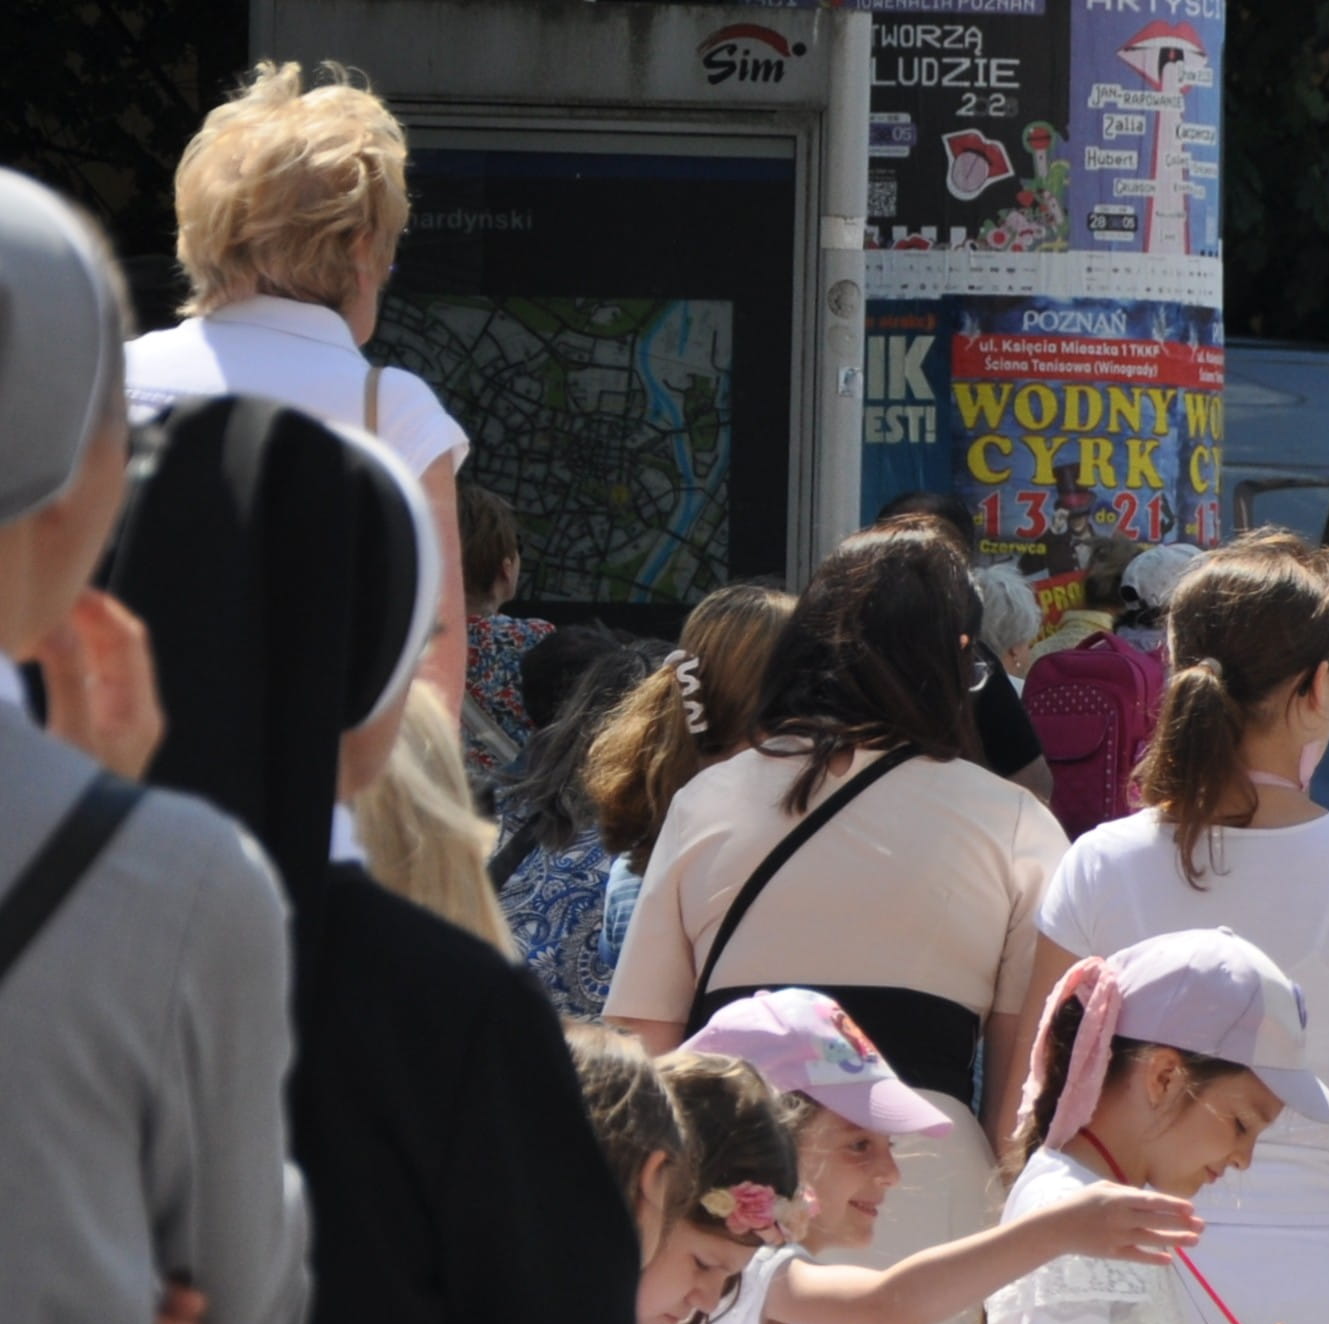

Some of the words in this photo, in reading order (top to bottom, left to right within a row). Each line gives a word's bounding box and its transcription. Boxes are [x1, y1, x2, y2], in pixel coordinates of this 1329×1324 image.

[702, 46, 785, 86] Sim
[871, 57, 1020, 88] LUDZIE
[1021, 307, 1127, 335] POZNAŃ
[979, 340, 998, 353] ul.
[1000, 339, 1058, 357] Księcia
[1061, 341, 1119, 357] Mieszka
[984, 355, 1028, 373] Ściana
[1030, 358, 1091, 376] Tenisowa
[1093, 359, 1159, 379] (Winogrady)
[951, 380, 1177, 437] WODNY
[966, 433, 1165, 489] CYRK
[979, 539, 1048, 556] Czerwca
